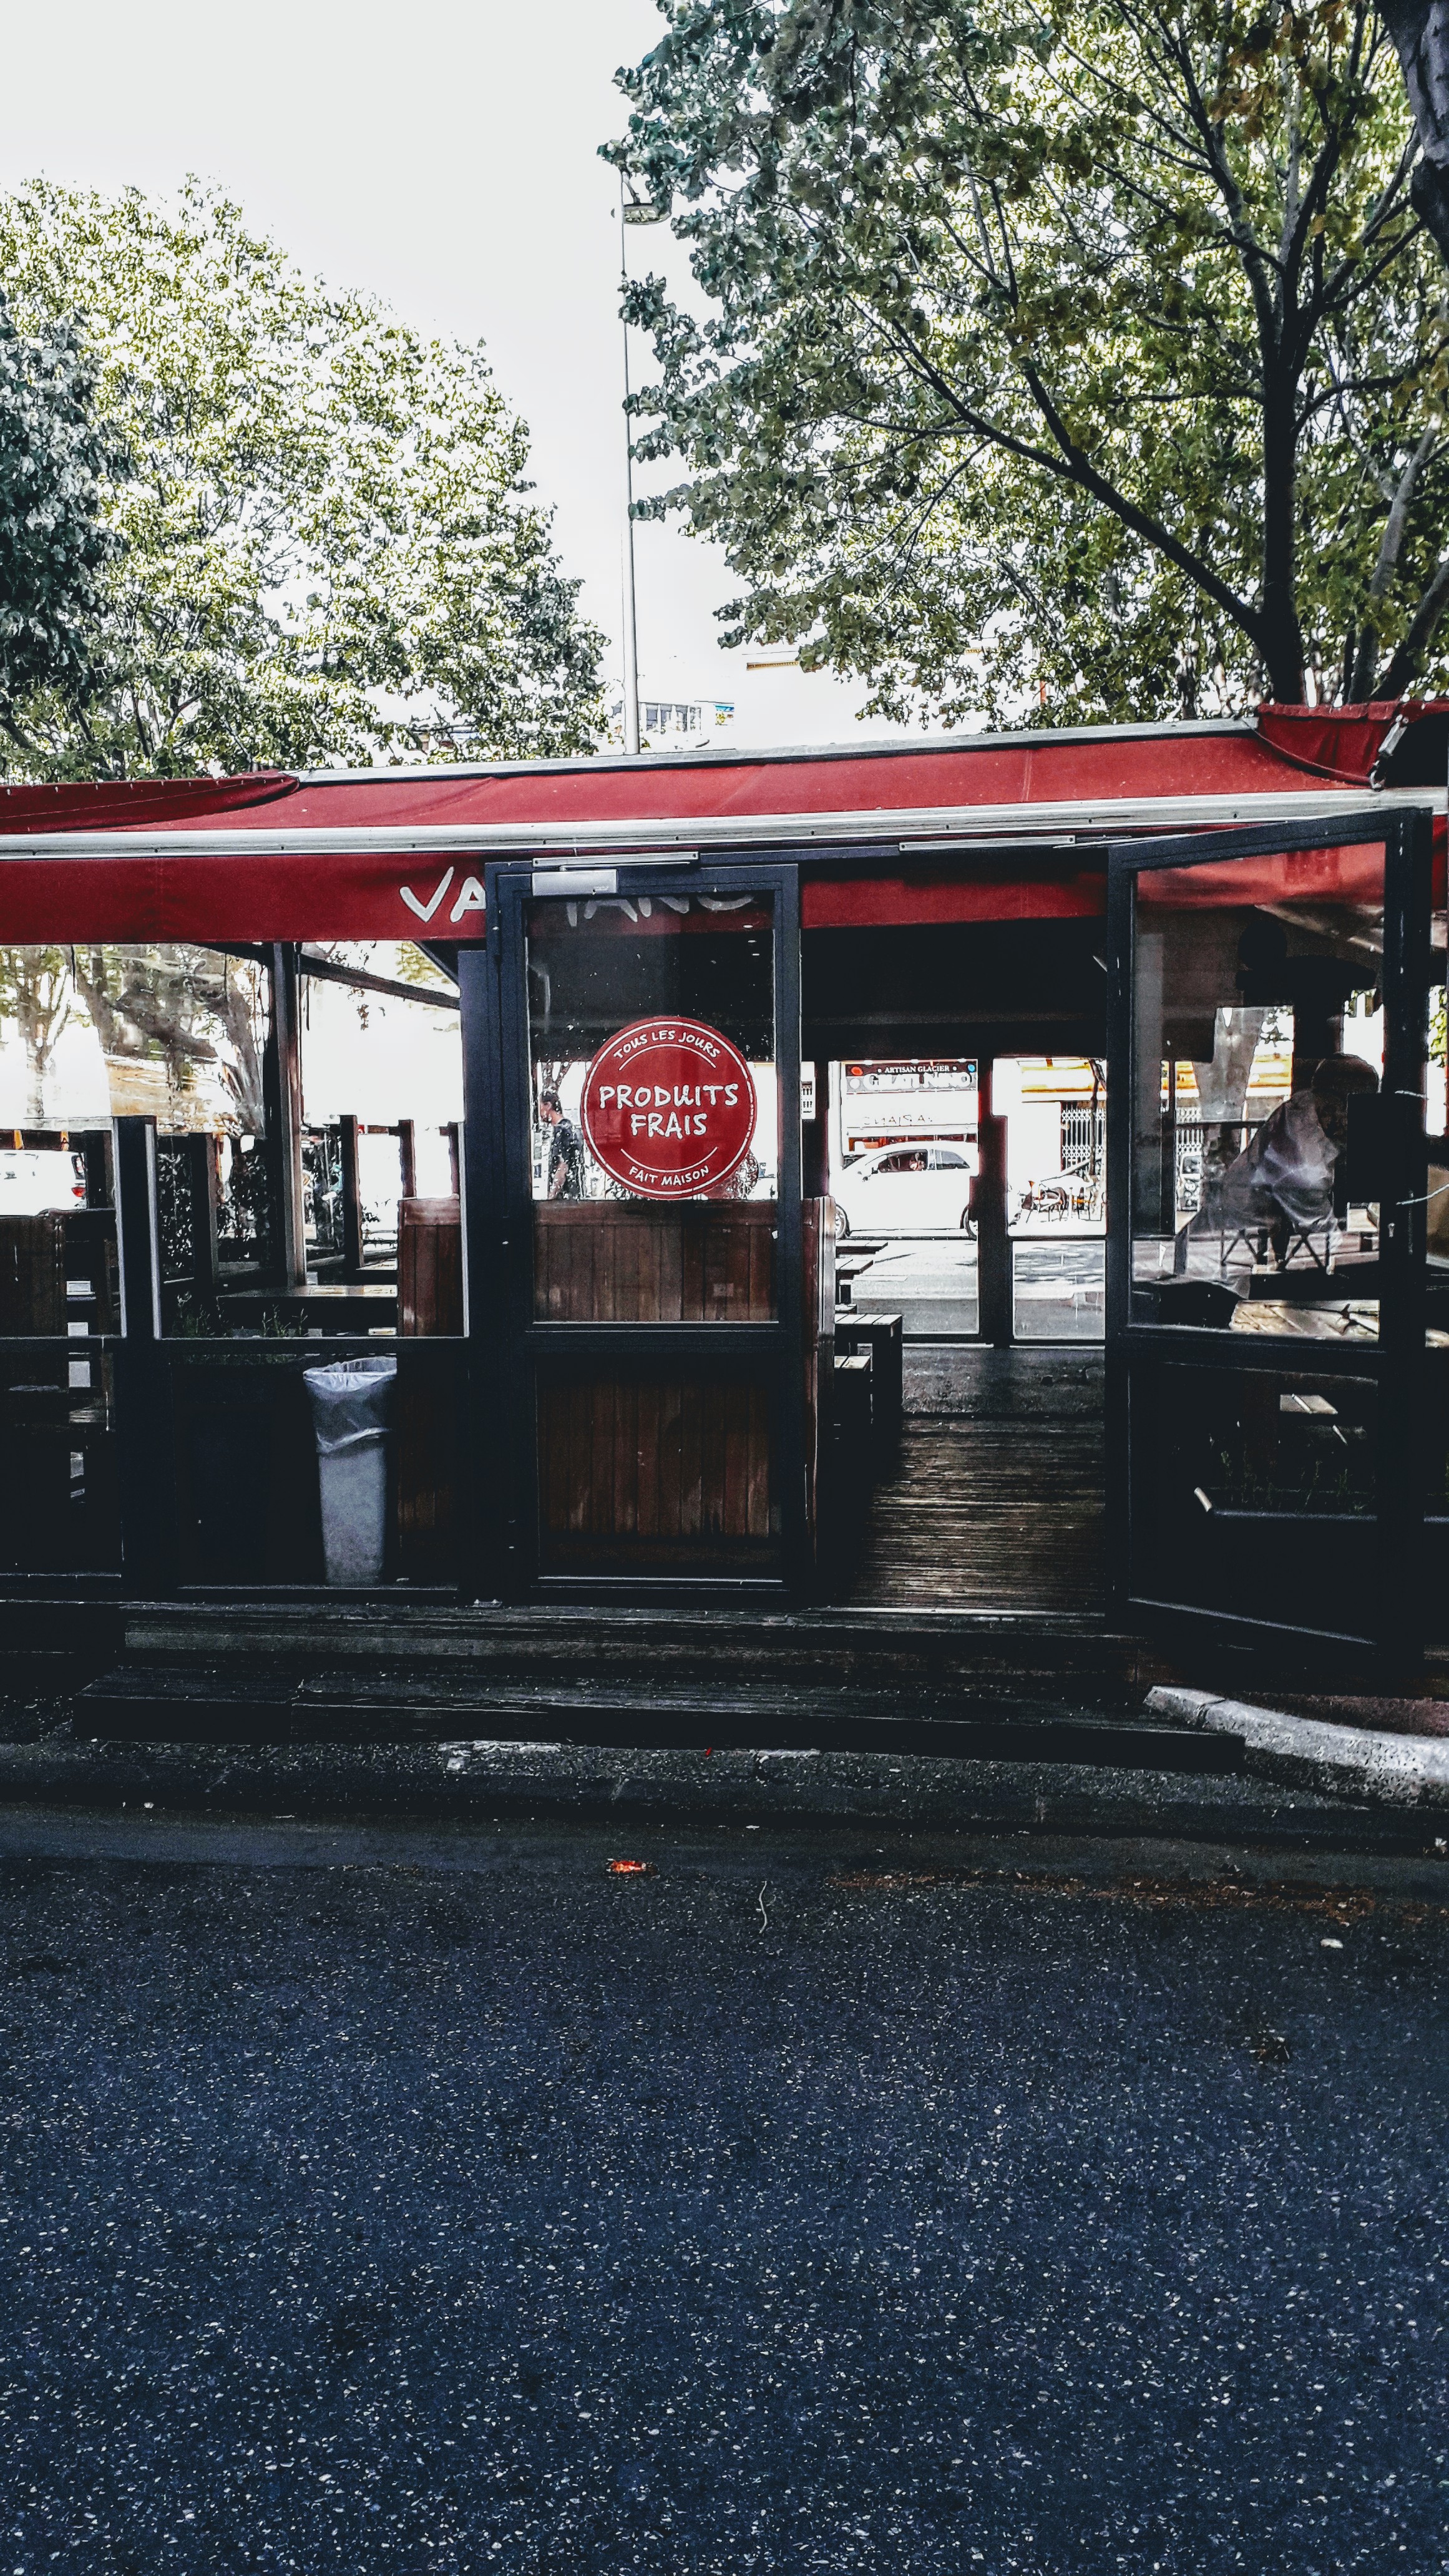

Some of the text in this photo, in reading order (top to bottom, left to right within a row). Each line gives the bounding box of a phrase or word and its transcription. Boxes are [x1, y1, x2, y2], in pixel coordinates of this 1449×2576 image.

[613, 1030, 721, 1059] TOUS LES JOURS
[600, 1083, 739, 1110] PRODUITS
[630, 1111, 708, 1139] FRAIS
[628, 1165, 710, 1186] FAIT MAISON
